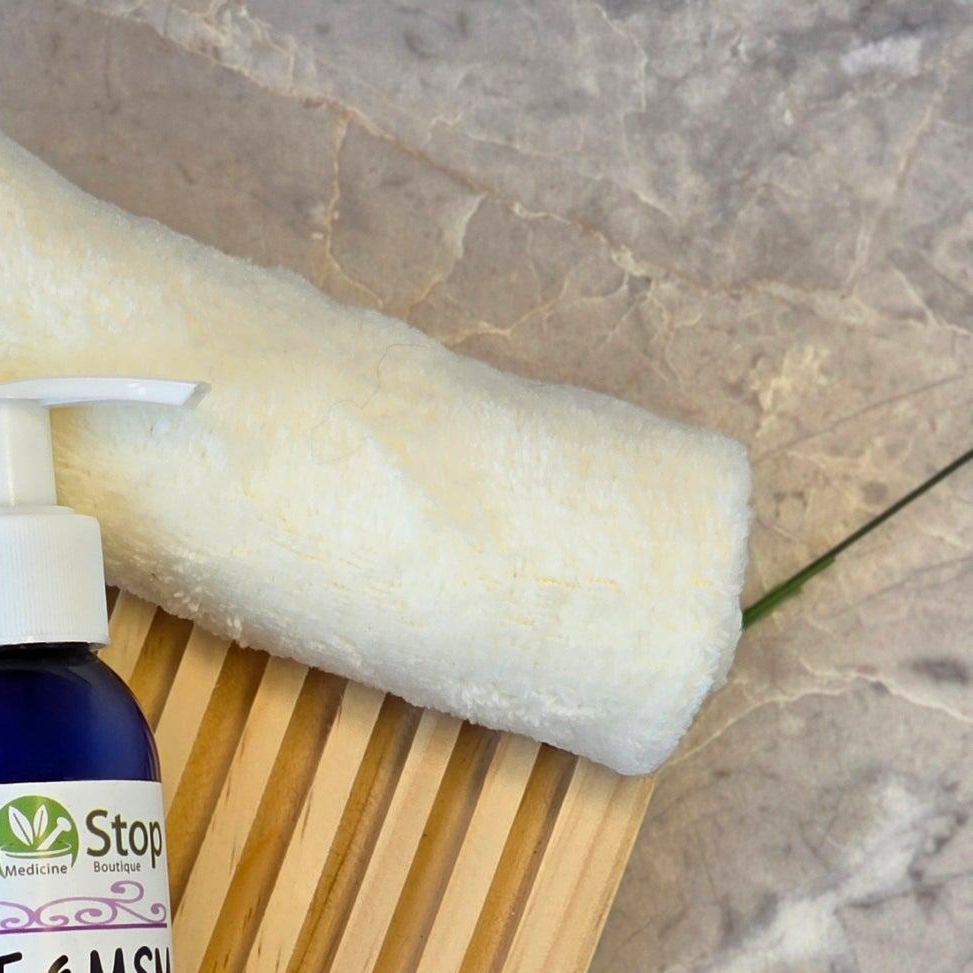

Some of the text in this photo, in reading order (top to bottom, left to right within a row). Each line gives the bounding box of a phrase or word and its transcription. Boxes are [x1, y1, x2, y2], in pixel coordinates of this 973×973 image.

[85, 809, 162, 868] Stop
[5, 863, 68, 877] Medicine
[93, 861, 141, 873] Boutique
